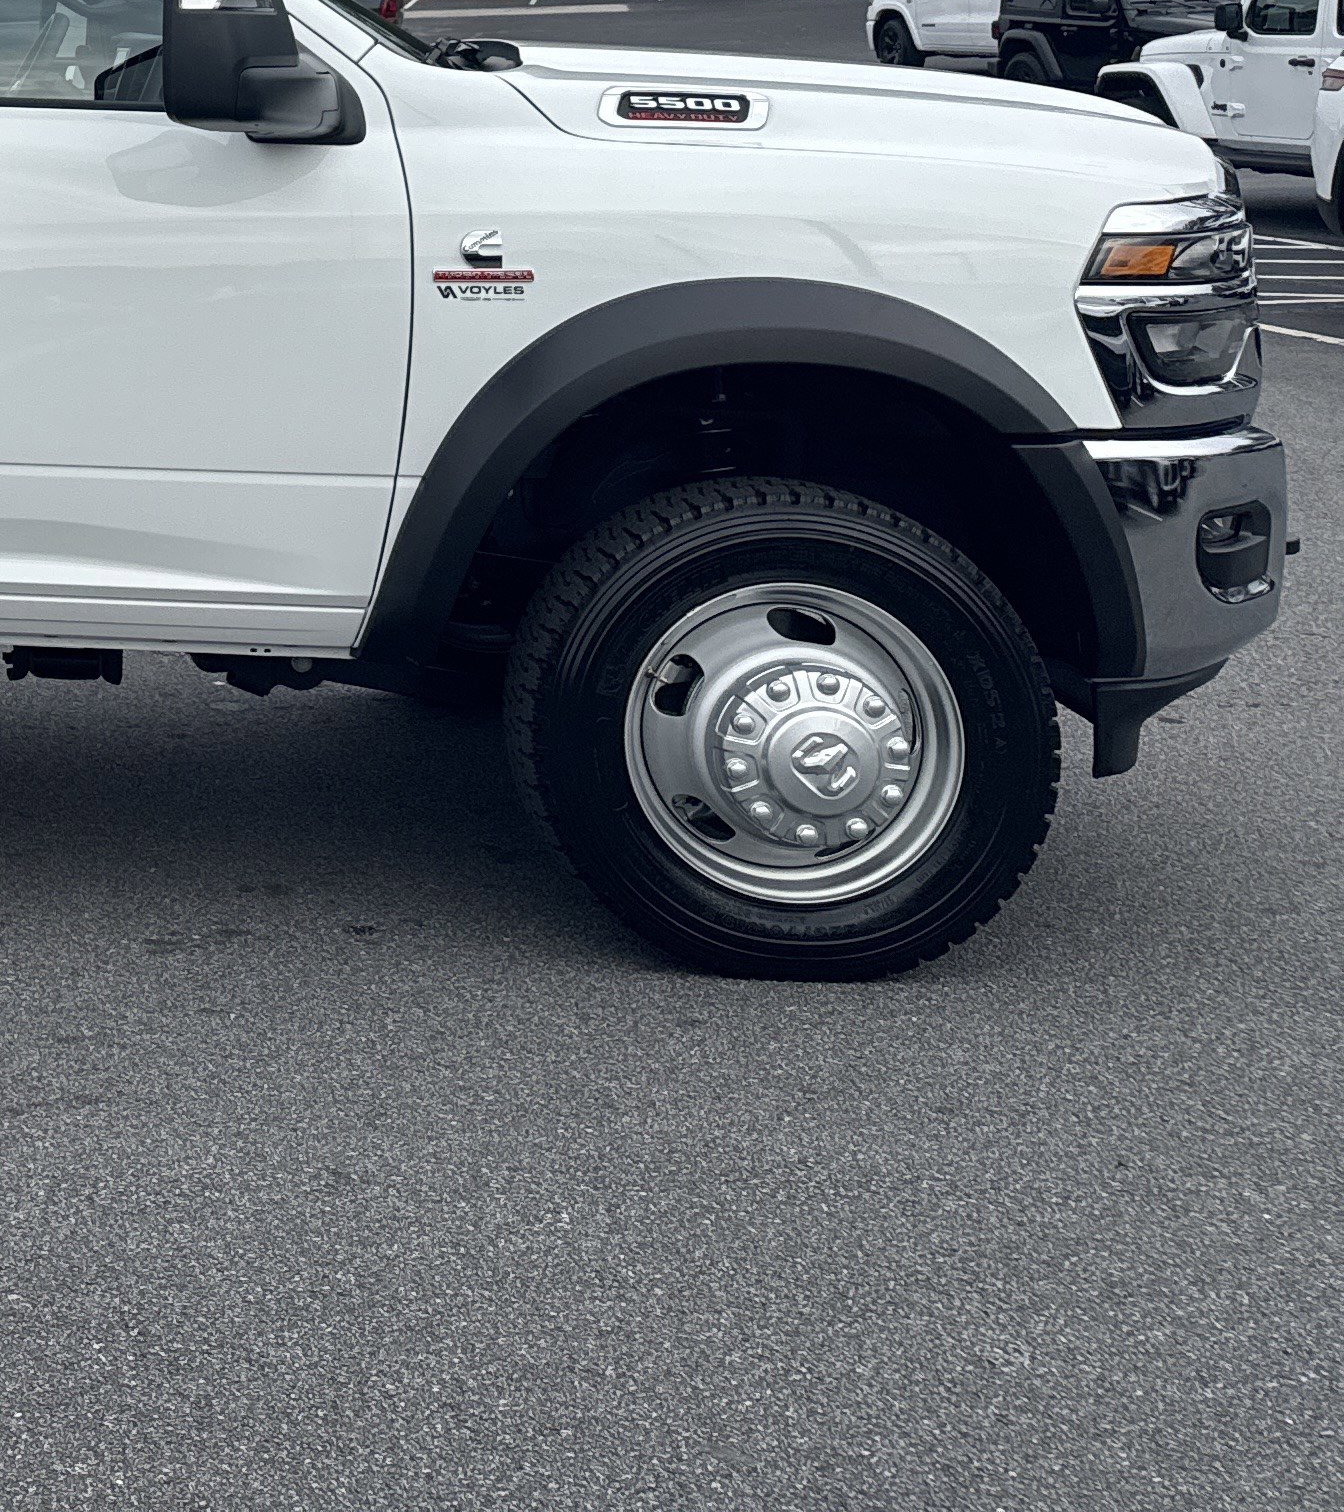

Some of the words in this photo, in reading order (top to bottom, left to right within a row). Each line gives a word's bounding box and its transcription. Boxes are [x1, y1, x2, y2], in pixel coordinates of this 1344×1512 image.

[629, 95, 741, 111] 5500
[628, 111, 687, 121] HEAVY
[691, 112, 738, 121] DUTY
[457, 286, 525, 295] VOYLES
